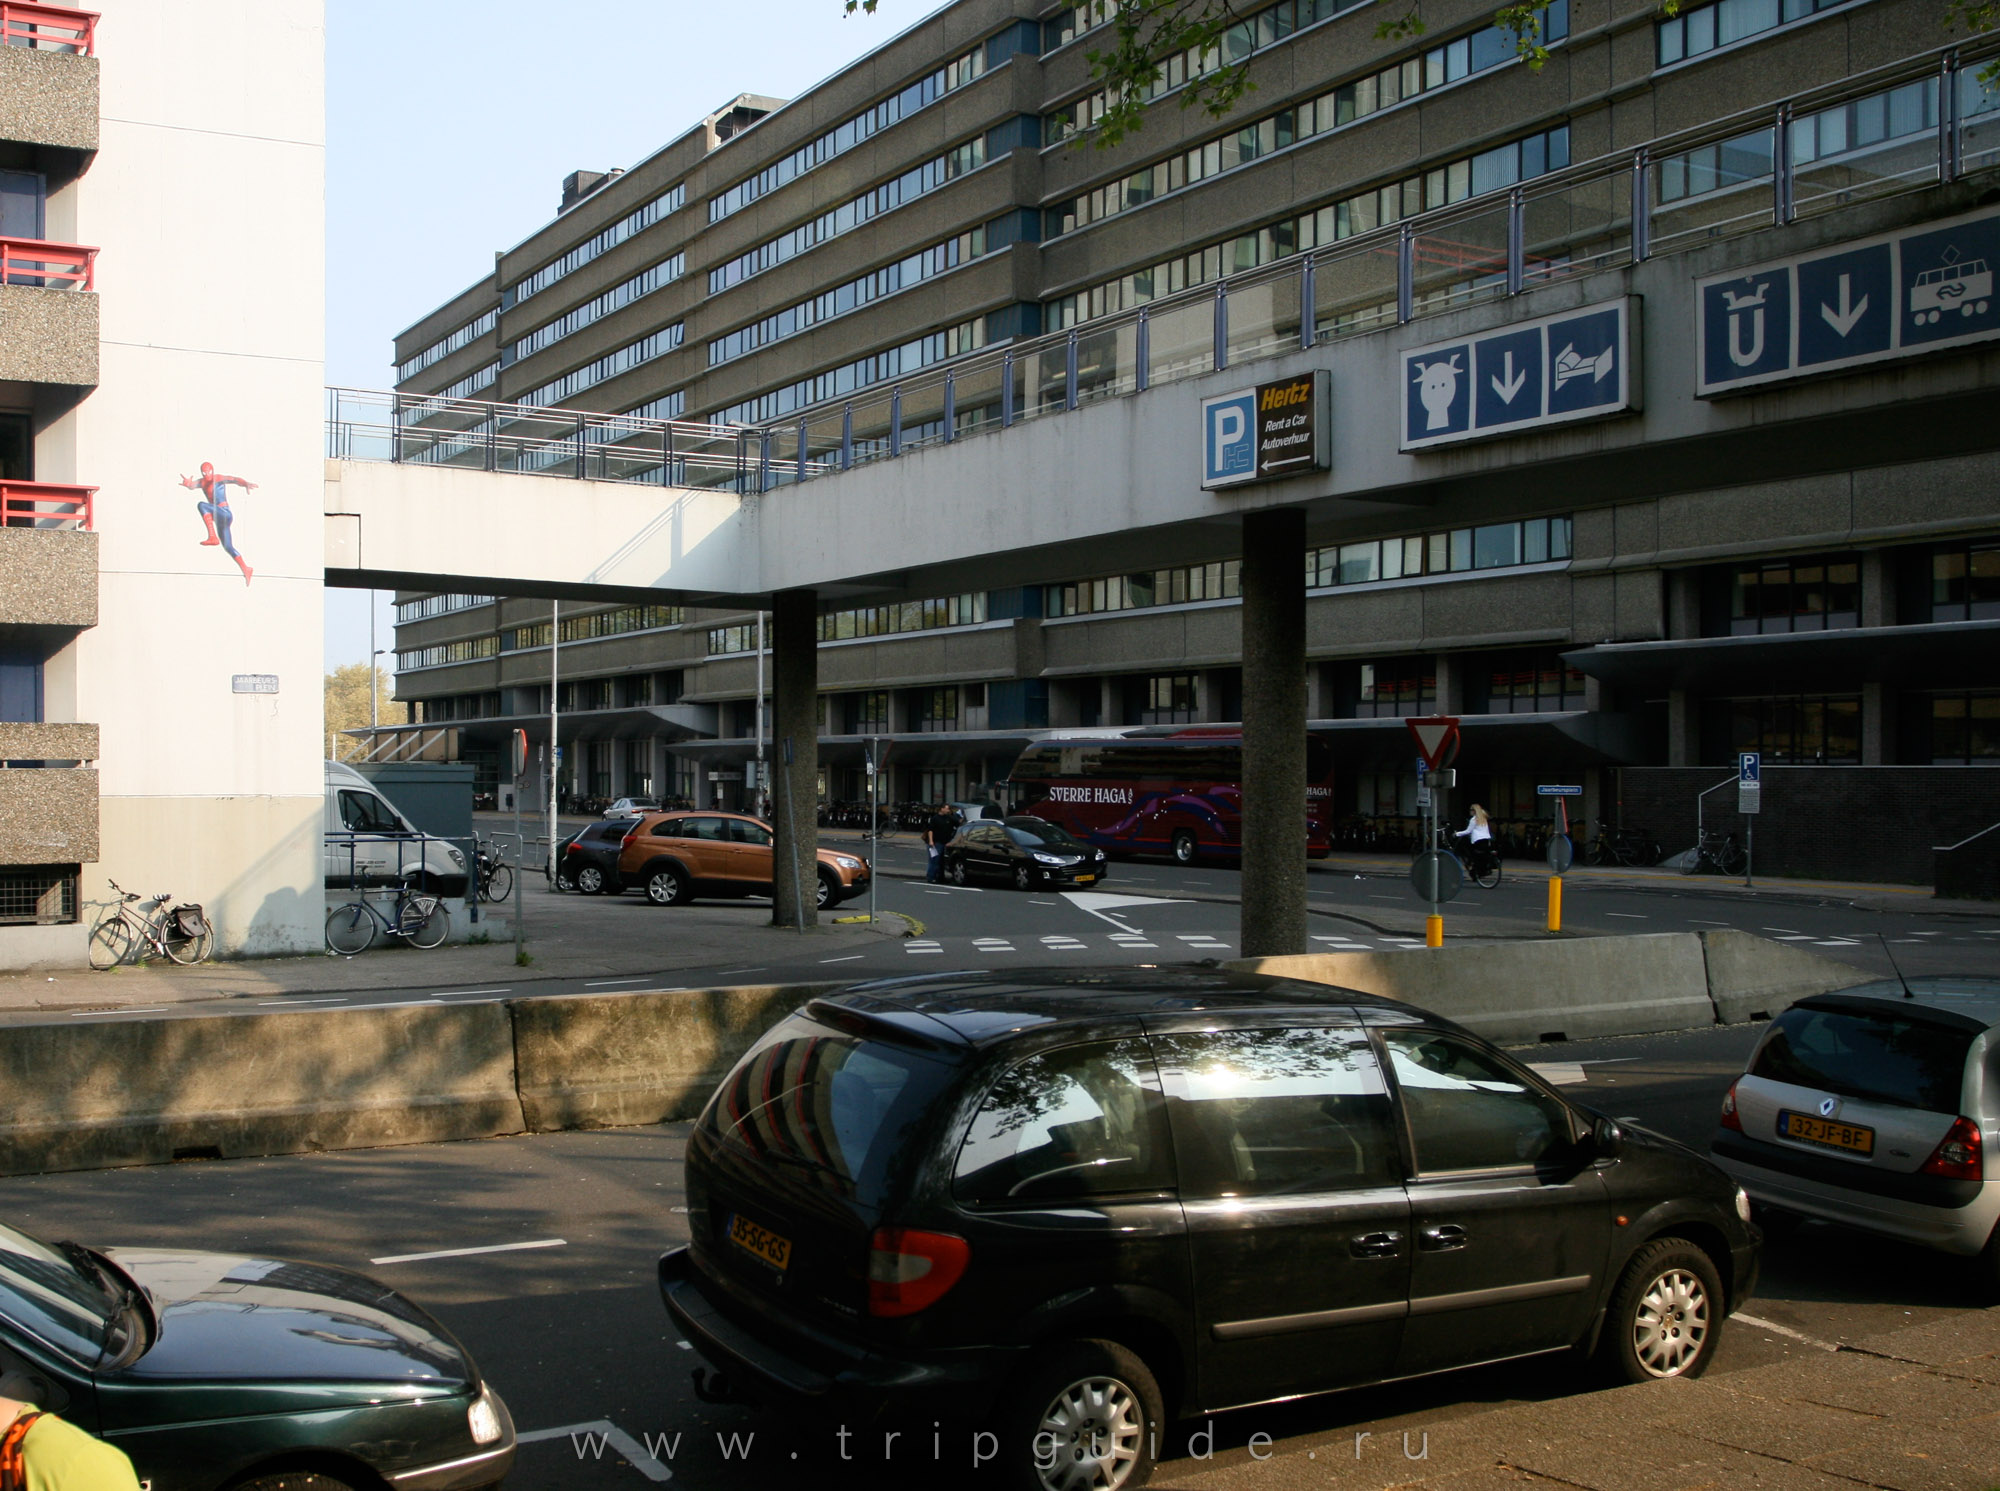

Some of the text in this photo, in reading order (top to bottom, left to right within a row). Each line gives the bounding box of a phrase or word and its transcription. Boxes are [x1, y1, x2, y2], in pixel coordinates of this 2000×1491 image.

[1261, 382, 1310, 411] Hertz
[1265, 414, 1307, 432] Rent a Car
[1215, 405, 1245, 472] P
[1261, 433, 1310, 450] Autoverhuur
[1744, 755, 1755, 769] P
[1049, 786, 1092, 803] SVERRE
[1094, 788, 1127, 804] HAGA
[1794, 1119, 1863, 1146] 32-JF-BF
[733, 1216, 786, 1262] 35-SG-GS
